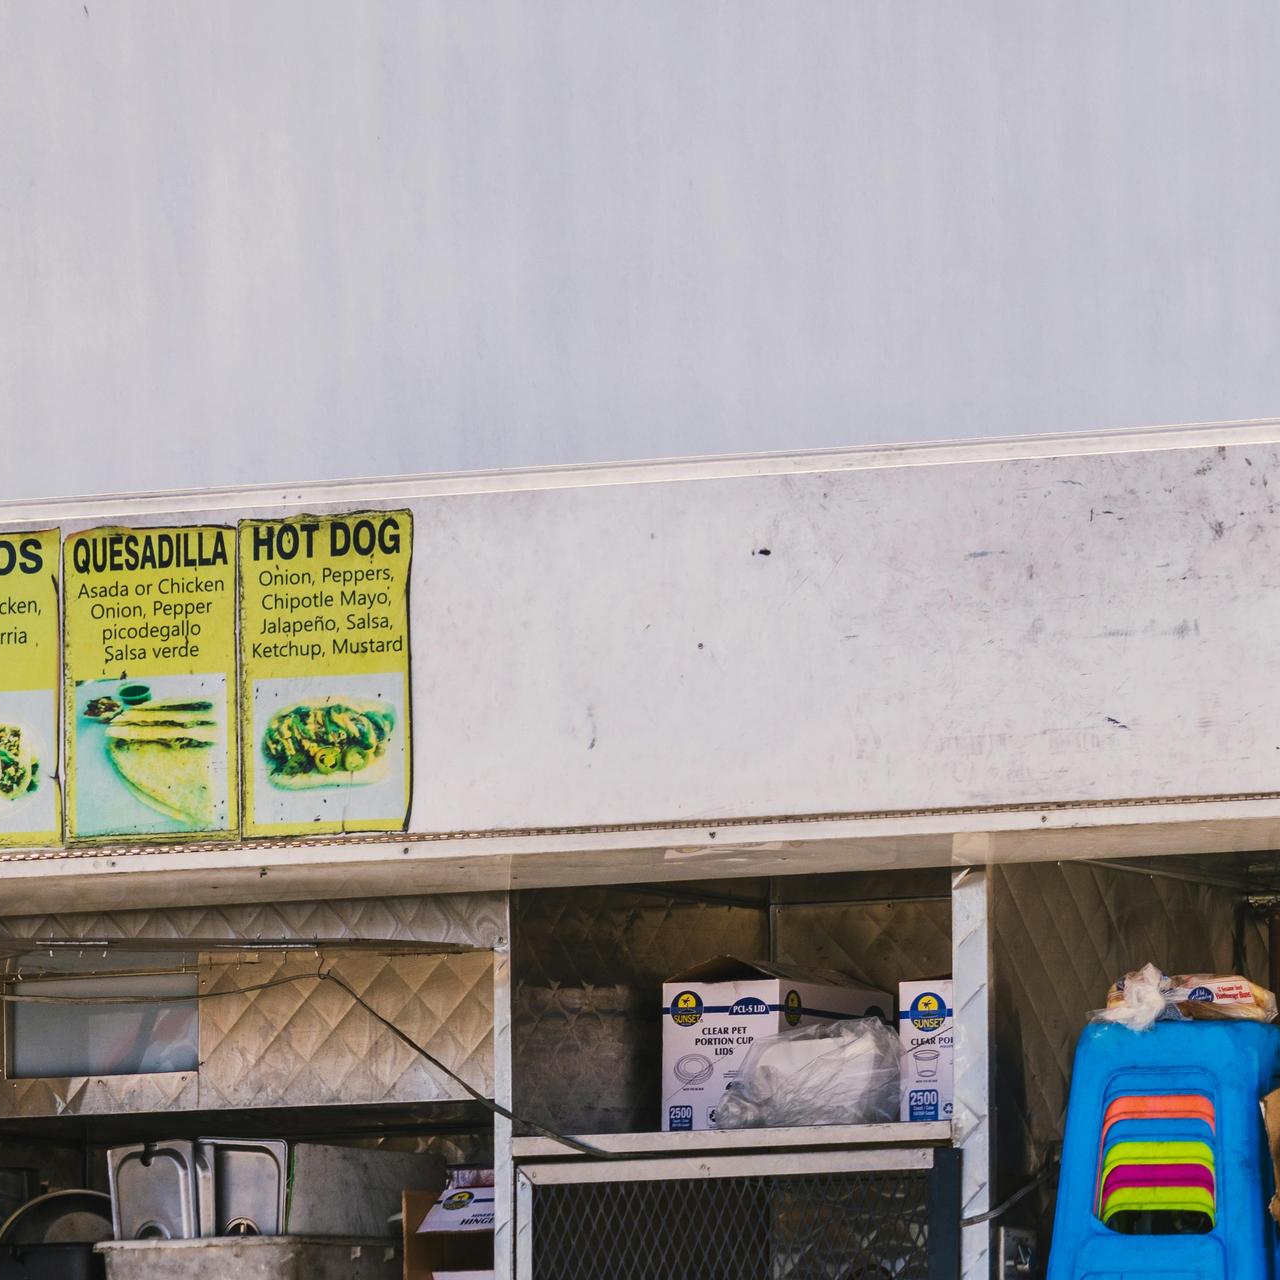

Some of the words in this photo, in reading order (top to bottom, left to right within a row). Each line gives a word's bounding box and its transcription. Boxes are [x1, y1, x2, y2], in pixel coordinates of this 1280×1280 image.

[253, 523, 320, 561] HOT
[330, 517, 401, 557] DOG
[73, 531, 228, 575] QUESADILLA
[258, 569, 315, 587] Onion,
[322, 567, 394, 586] Peppers,
[78, 581, 129, 599] Asada
[135, 583, 153, 596] or
[158, 577, 224, 595] Chicken
[90, 603, 146, 620] Onion,
[153, 601, 212, 620] Pepper
[261, 591, 334, 613] Chipotle
[340, 590, 392, 610] Mayo,
[102, 620, 201, 644] picodegallo
[260, 616, 340, 637] Jalapeño,
[346, 613, 393, 630] Salsa,
[105, 644, 146, 662] Salsa
[152, 643, 199, 659] verde
[252, 641, 326, 660] Ketchup,
[332, 636, 403, 654] Mustard
[754, 1004, 766, 1012] LID
[701, 1027, 729, 1036] CLEAR
[731, 1026, 748, 1035] PET
[913, 1017, 945, 1029] SUNSET
[695, 1037, 734, 1046] PORTION
[736, 1036, 754, 1045] CUP
[910, 1036, 936, 1047] CLEAR
[714, 1047, 734, 1056] LIDS
[910, 1090, 938, 1106] 2500
[670, 1107, 692, 1119] 2500
